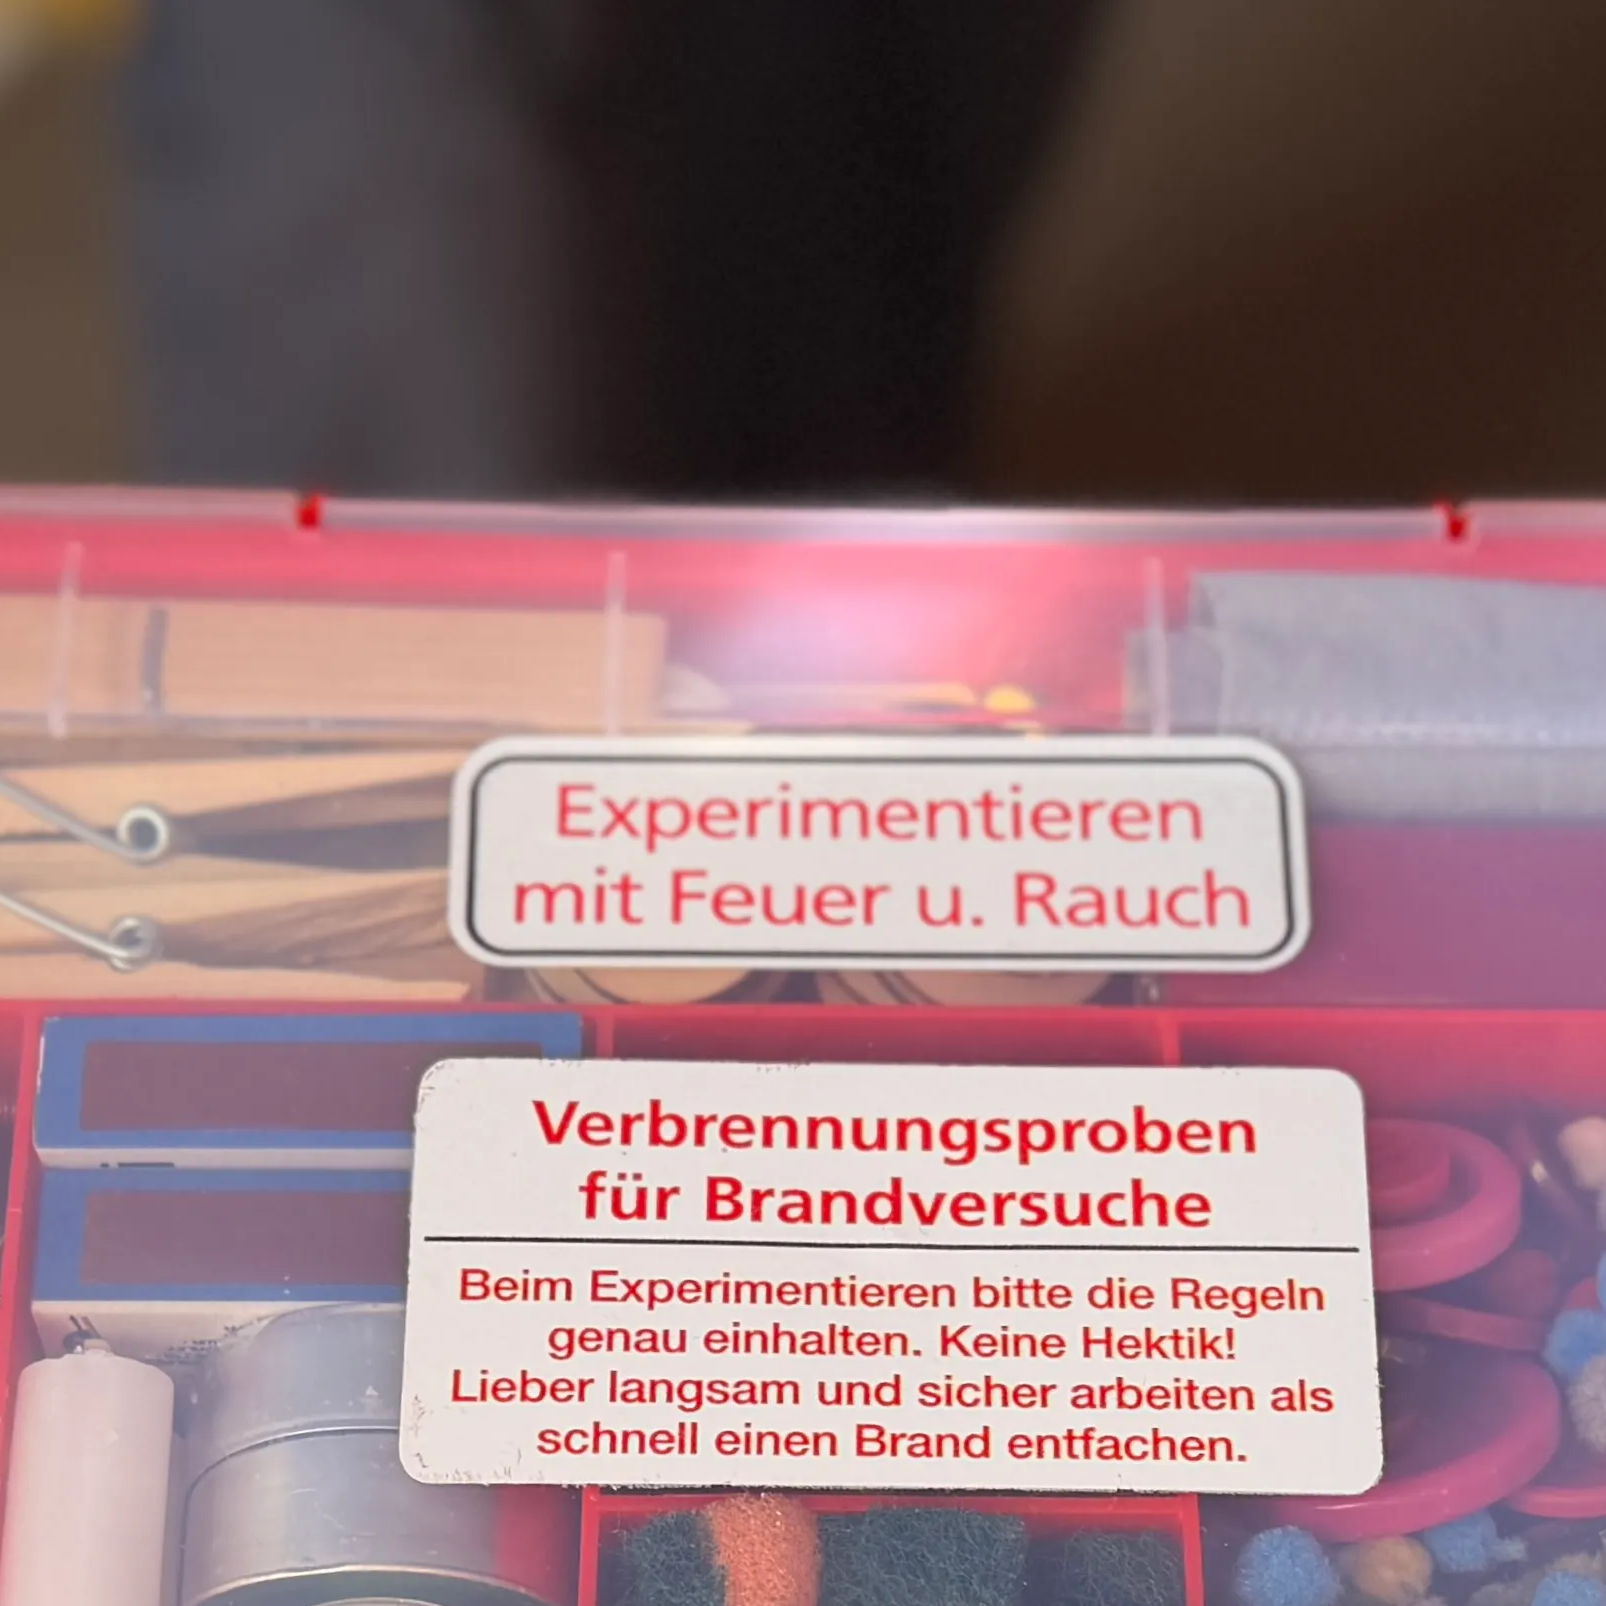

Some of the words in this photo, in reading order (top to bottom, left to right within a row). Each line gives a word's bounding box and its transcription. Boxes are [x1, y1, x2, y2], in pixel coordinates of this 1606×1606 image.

[557, 782, 1204, 854] Experimentieren
[514, 866, 643, 926] mit
[672, 870, 888, 926] Feuer
[919, 888, 983, 927] u.
[1015, 870, 1249, 928] Rauch
[533, 1099, 1256, 1166] Verbrennungsproben
[580, 1170, 680, 1221] für
[706, 1176, 1211, 1228] Brandversuche
[461, 1269, 572, 1302] Beim
[591, 1270, 956, 1311] Experimentieren
[972, 1275, 1073, 1310] bitte
[1087, 1276, 1155, 1311] die
[1171, 1278, 1324, 1319] Regeln
[549, 1328, 687, 1360] genau
[704, 1323, 920, 1357] einhalten.
[941, 1326, 1066, 1358] Keine
[1083, 1328, 1234, 1360] Hektik!
[452, 1371, 594, 1403] Lieber
[610, 1372, 800, 1413] langsam
[819, 1376, 901, 1406] und
[919, 1376, 1056, 1408] sicher
[1071, 1378, 1254, 1411] arbeiten
[1271, 1380, 1334, 1412] als
[539, 1423, 698, 1455] schnell
[715, 1431, 837, 1457] einen
[856, 1424, 990, 1459] Brand
[1008, 1428, 1245, 1462] entfachen.
